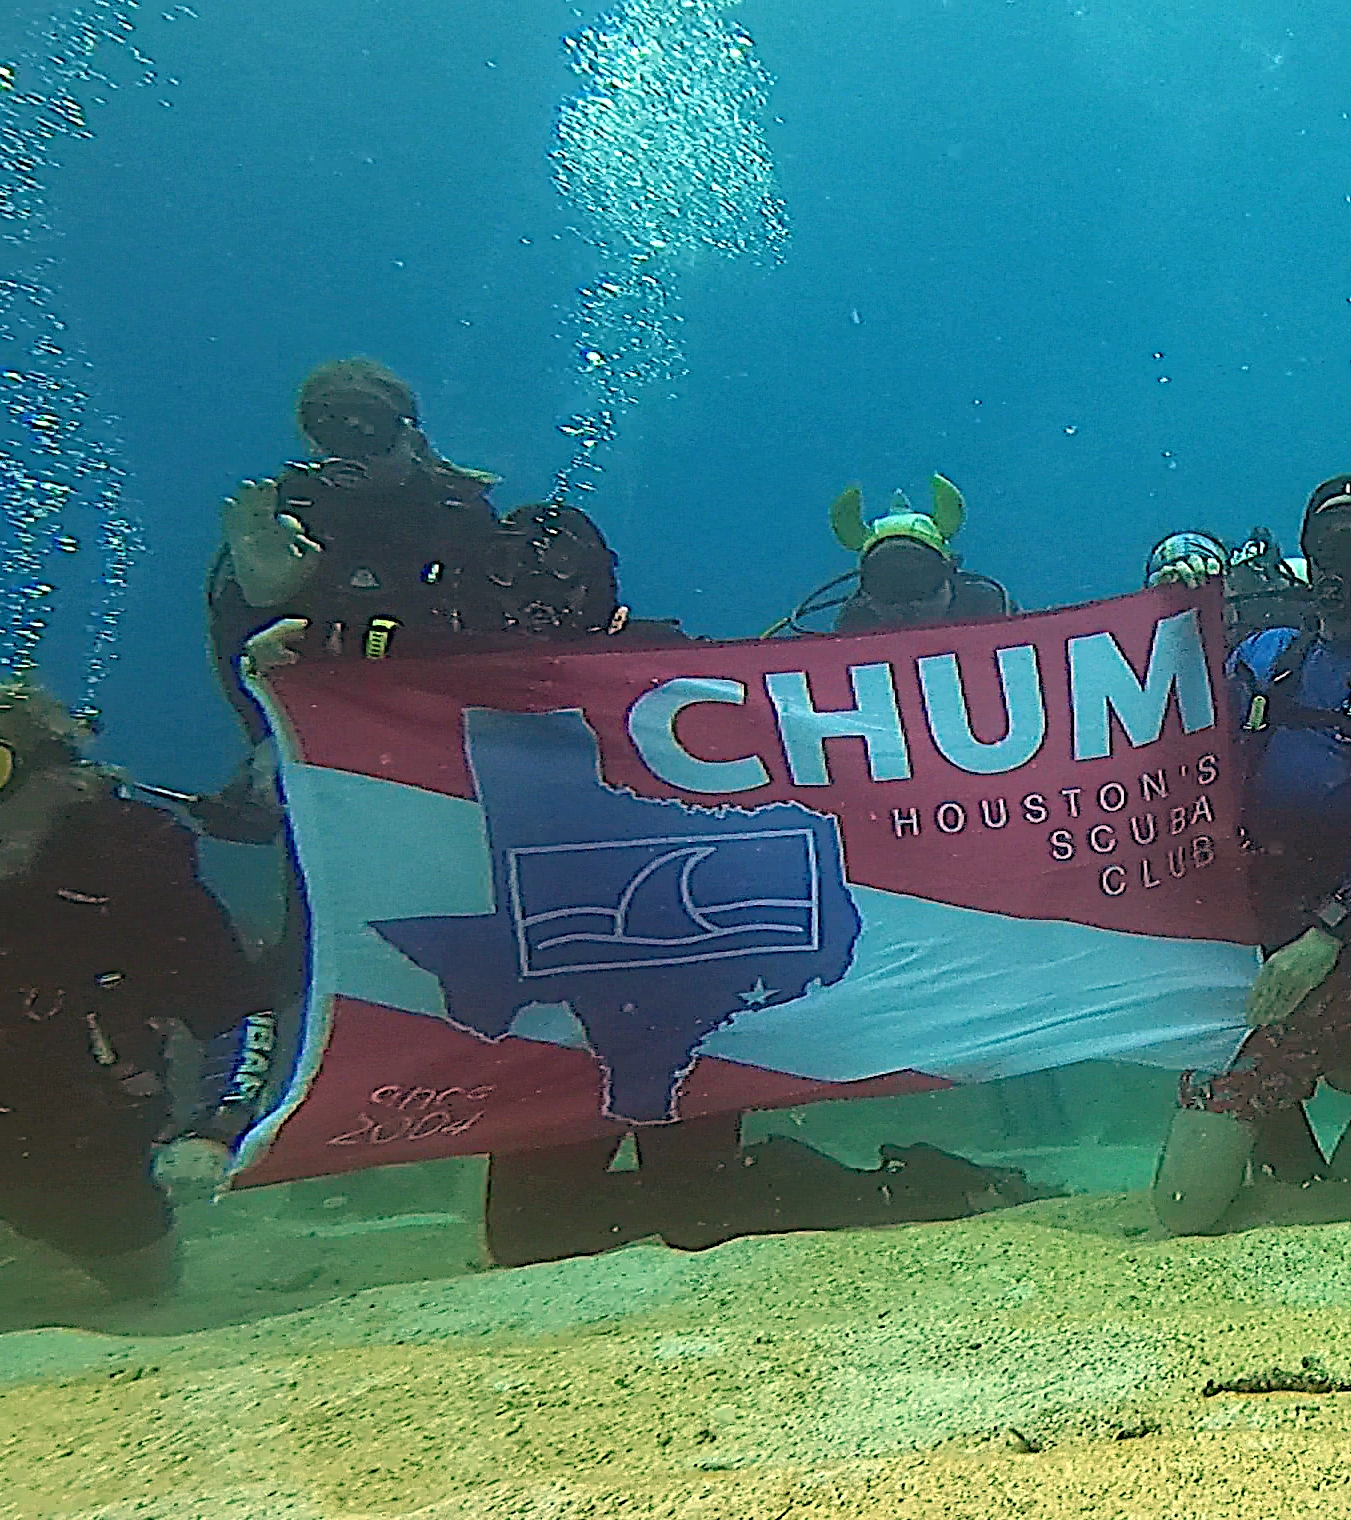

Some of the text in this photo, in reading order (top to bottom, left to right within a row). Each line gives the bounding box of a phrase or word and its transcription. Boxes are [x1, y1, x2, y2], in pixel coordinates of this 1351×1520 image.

[626, 608, 1217, 796] CHUM
[890, 753, 1219, 838] HOUSTON'S
[1049, 794, 1216, 861] SCUBA
[1100, 835, 1216, 896] CLUB
